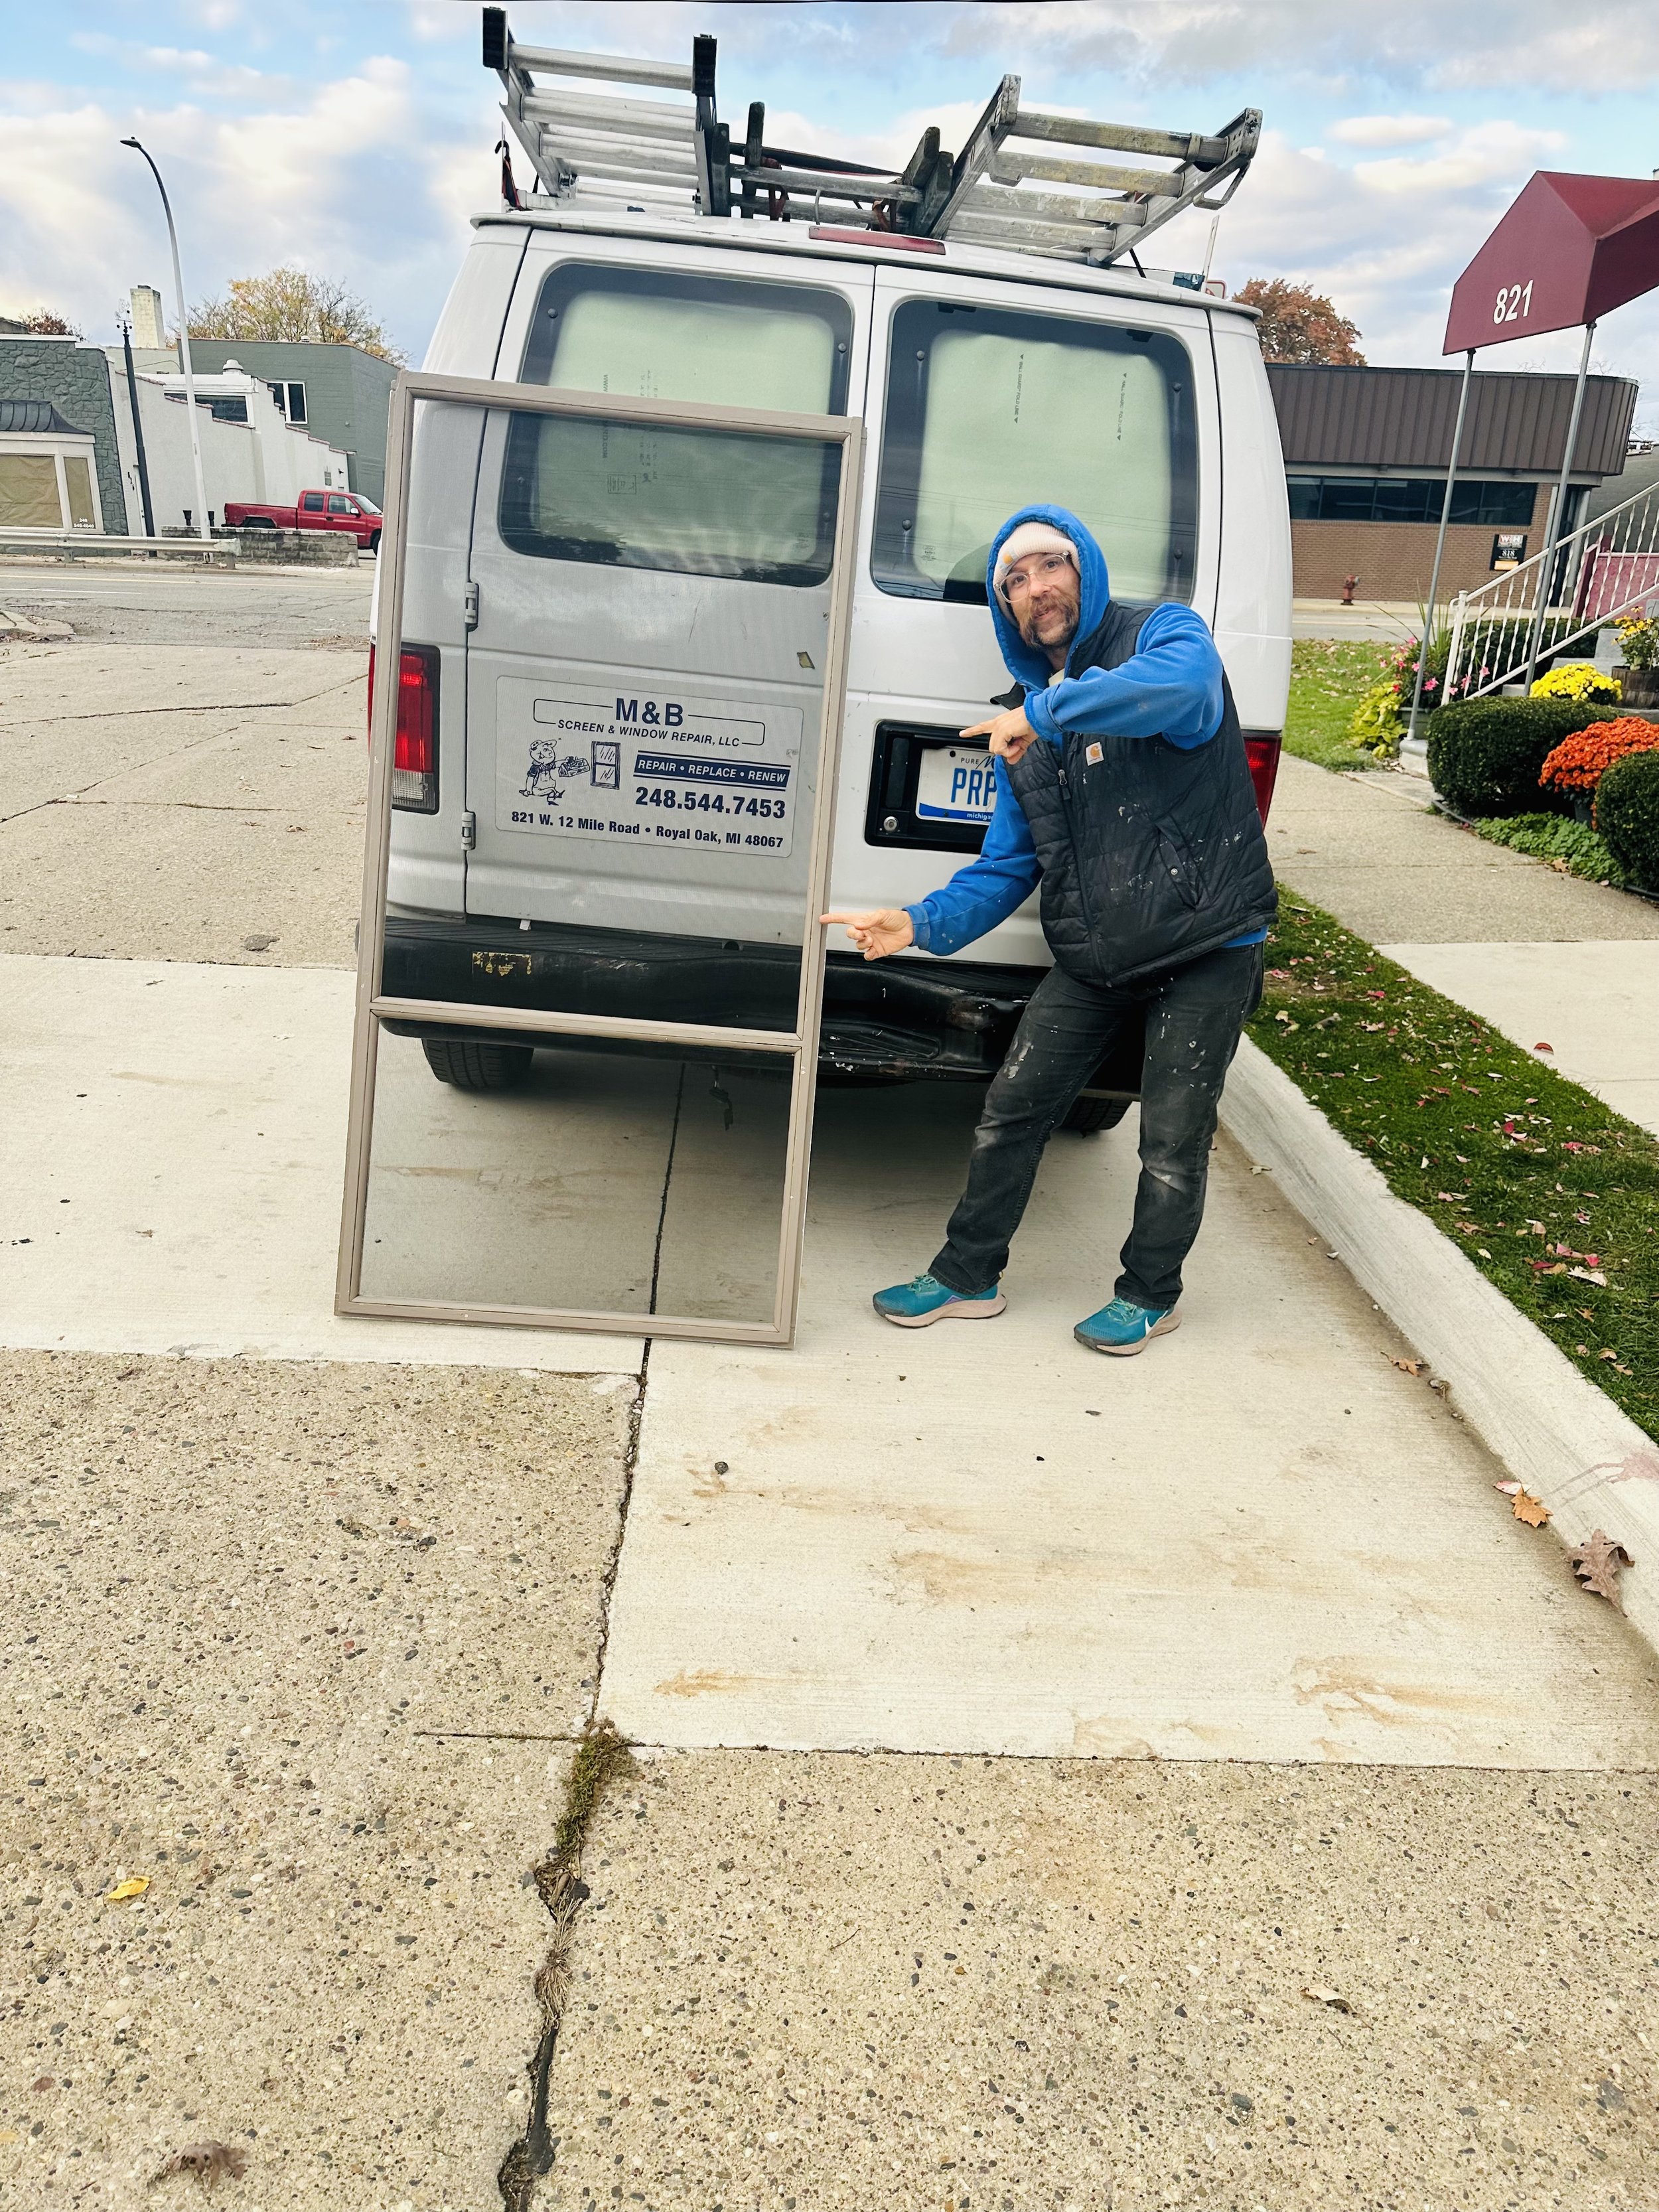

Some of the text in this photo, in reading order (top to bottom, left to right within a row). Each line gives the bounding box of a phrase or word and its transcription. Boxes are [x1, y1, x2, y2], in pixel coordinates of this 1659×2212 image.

[1493, 279, 1534, 325] 821
[616, 698, 684, 727] M&B
[557, 719, 739, 747] SCREEN & WINDOW REPAIR, LLC
[638, 759, 786, 783] REPAIR REPLACE RENEW
[636, 787, 785, 819] 248.544.7453
[511, 811, 784, 848] 821 W. 12 Mile Road Royal Oak, MI 48067
